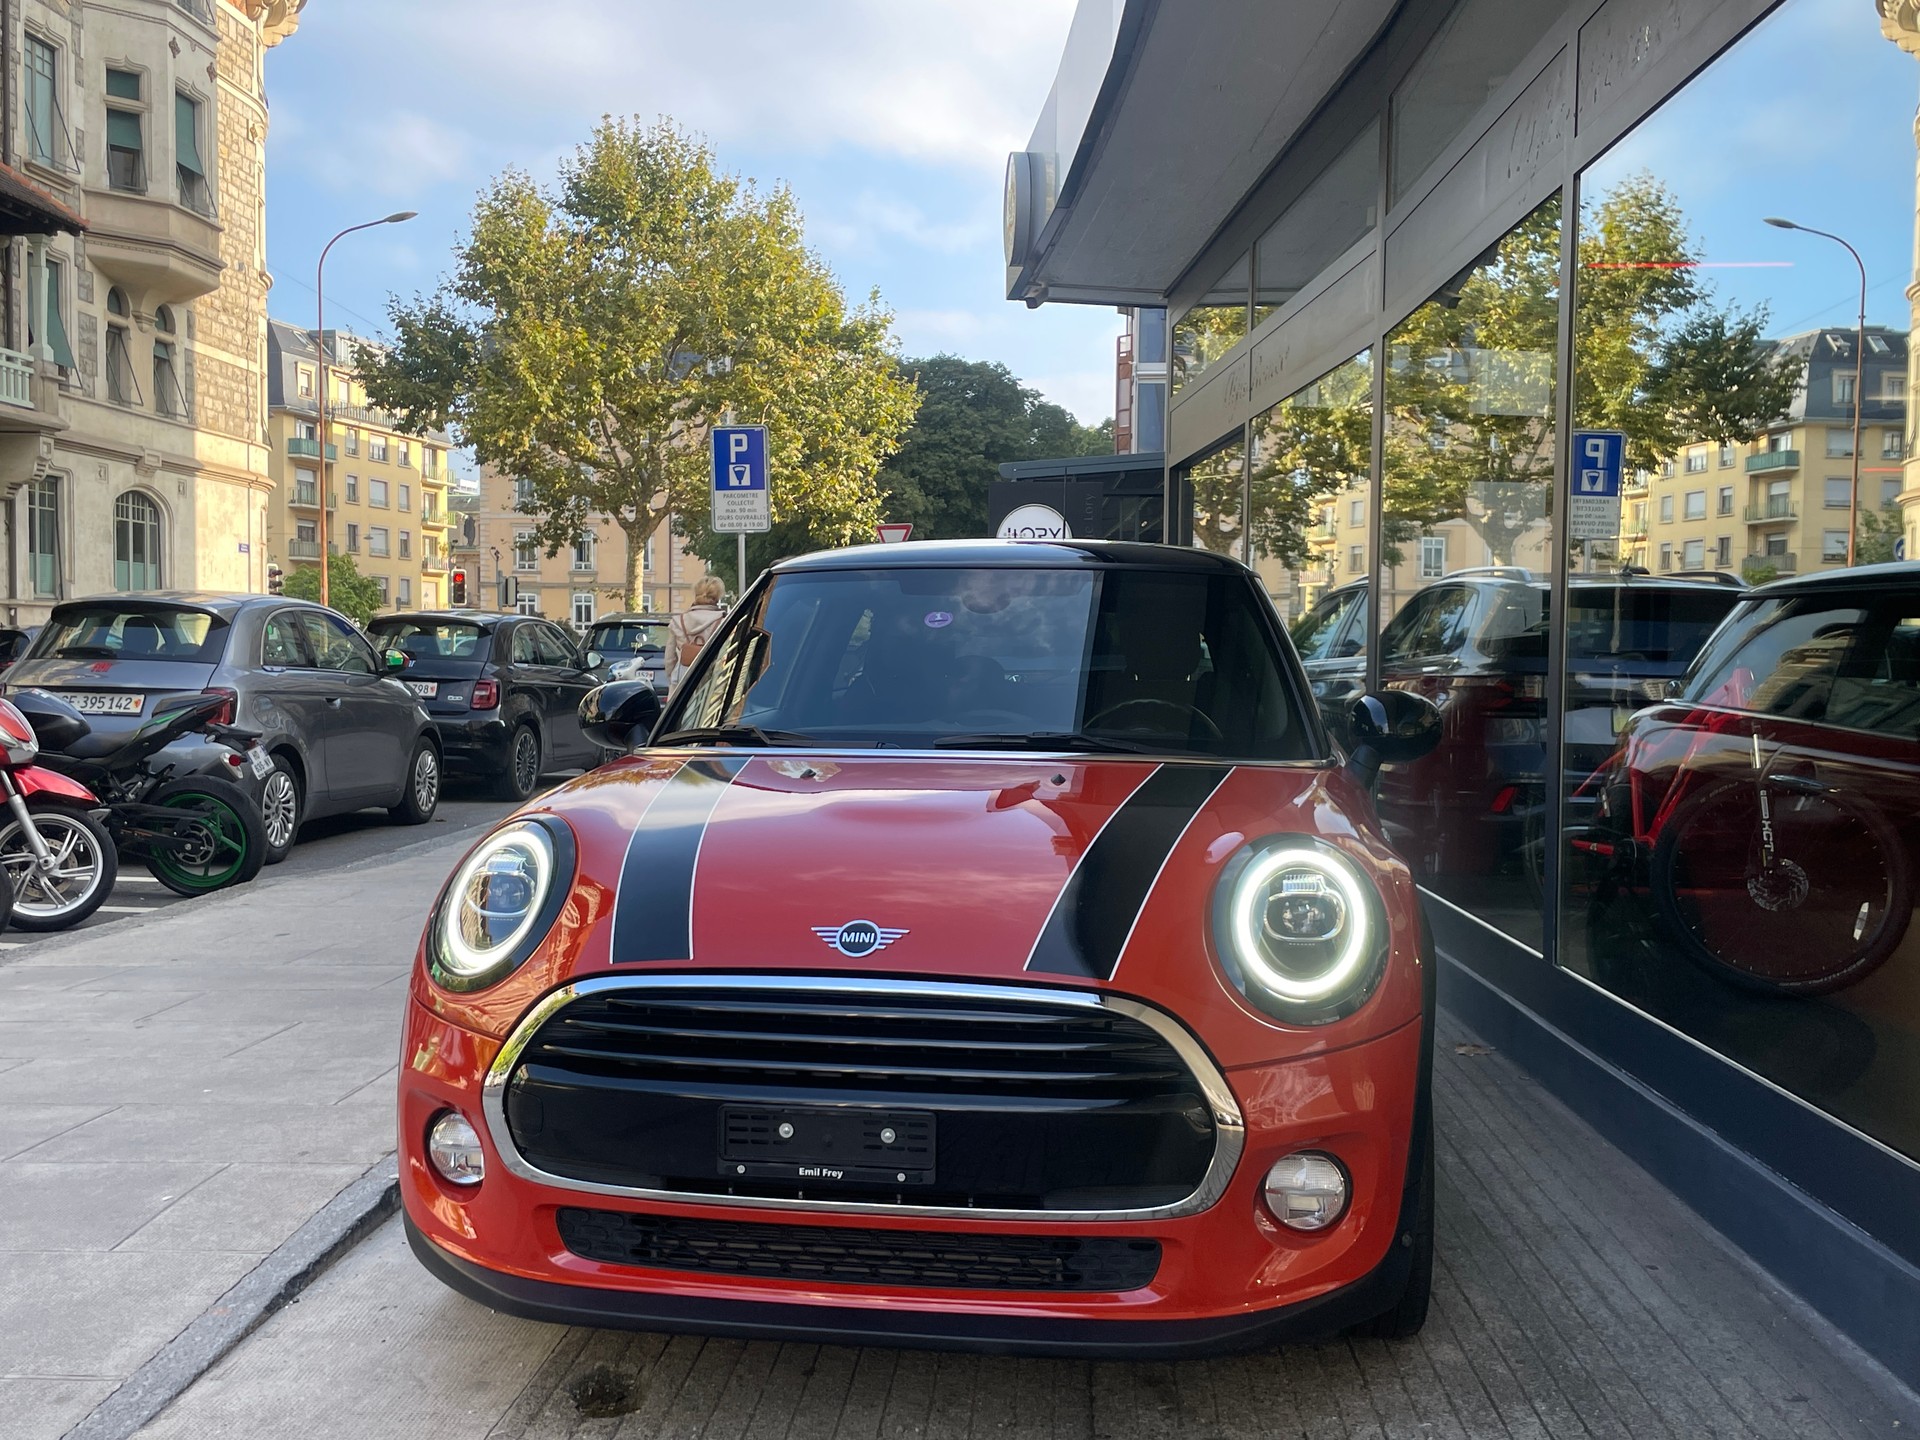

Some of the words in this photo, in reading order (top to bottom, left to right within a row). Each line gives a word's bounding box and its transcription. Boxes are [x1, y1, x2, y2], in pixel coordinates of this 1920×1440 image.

[729, 433, 748, 463] P
[1762, 820, 1774, 852] XCT
[842, 932, 875, 943] MINI
[799, 1167, 820, 1176] Emil
[822, 1168, 843, 1179] Frey
